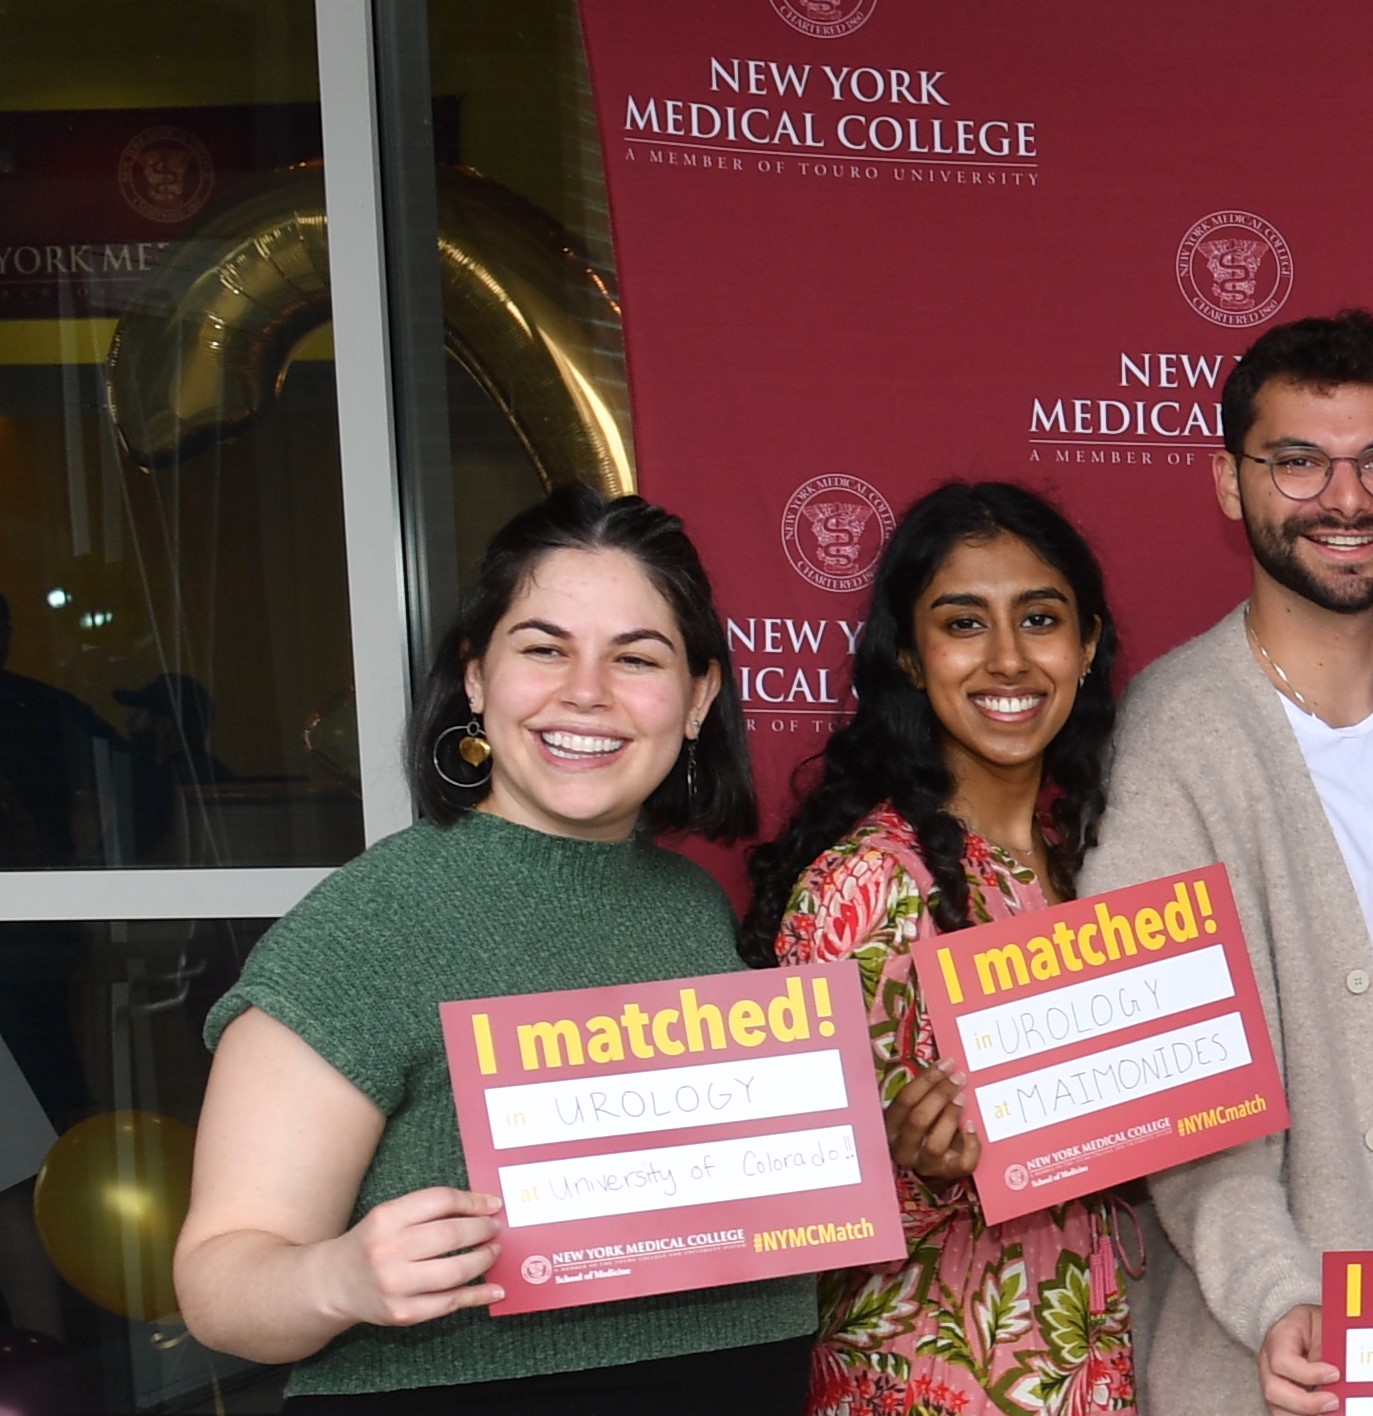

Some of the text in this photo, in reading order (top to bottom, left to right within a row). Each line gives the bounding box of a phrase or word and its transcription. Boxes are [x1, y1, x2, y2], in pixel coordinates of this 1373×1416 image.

[711, 57, 949, 105] NEW YORK
[625, 96, 1036, 156] MEDICAL COLLEGE
[626, 148, 1038, 186] A MEMBER OF TOURO UNIVERSITY
[1120, 353, 1223, 388] NEW
[727, 617, 828, 654] NEW
[938, 881, 1217, 1003] I matched!
[473, 977, 835, 1075] I matched!
[995, 978, 1160, 1055] UROLOGY
[555, 1076, 755, 1126] UROLOGY
[1015, 1033, 1228, 1123] MAIMONIDES
[1177, 1095, 1267, 1136] #NYMCmatch
[1027, 1117, 1171, 1170] NEW YORK MEDICAL COLLEGE
[549, 1161, 676, 1200] University
[691, 1160, 716, 1181] of
[553, 1251, 583, 1264] NEW
[586, 1246, 624, 1260] YORK
[626, 1237, 684, 1255] MEDICAL
[687, 1229, 745, 1248] COLLEGE
[754, 1219, 874, 1252] #NYMCMatch
[1346, 1263, 1362, 1317] I
